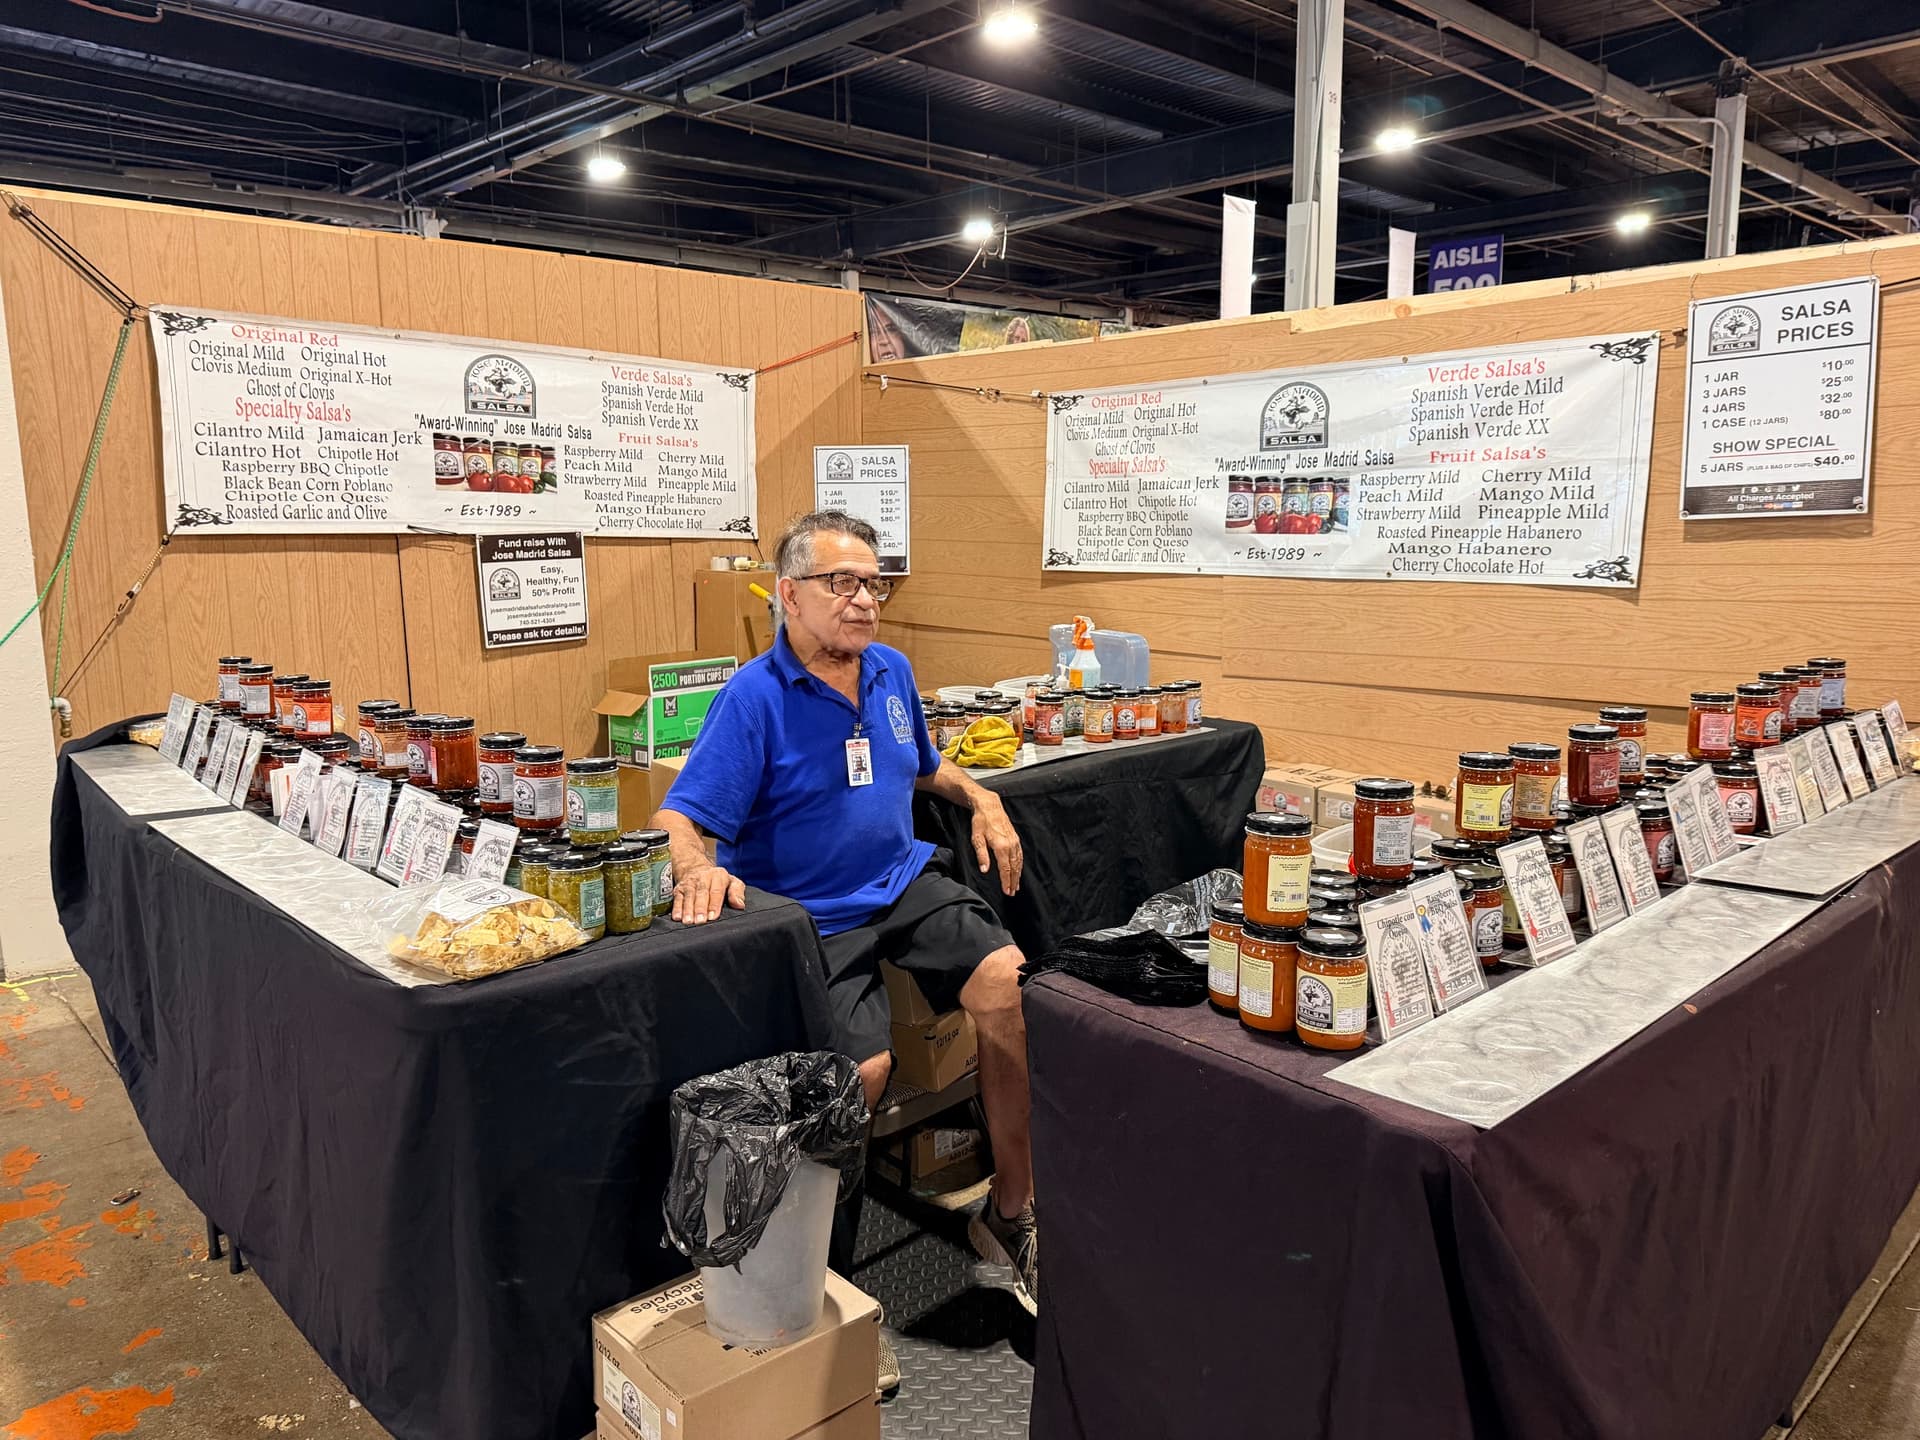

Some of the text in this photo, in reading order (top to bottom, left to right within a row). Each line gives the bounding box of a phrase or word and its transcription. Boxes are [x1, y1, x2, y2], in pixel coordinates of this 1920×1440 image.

[1434, 243, 1498, 269] AISLE
[1781, 299, 1851, 321] SALSA
[232, 324, 338, 347] Original Red
[1777, 321, 1854, 344] PRICES
[189, 340, 285, 361] Original Mild
[1717, 341, 1751, 350] SALSA
[300, 347, 386, 367] Original Hot
[191, 358, 292, 378] Clovis Medium
[300, 367, 392, 386] Original X-Hot
[1428, 358, 1546, 384] Verde Salsa's
[1705, 374, 1709, 383] 1
[1714, 372, 1739, 382] JAR
[246, 379, 335, 400] Ghost of Clovis
[1411, 376, 1563, 407] Spanish Verde Mild
[1703, 389, 1709, 398] 3
[1714, 386, 1746, 398] JARS
[236, 397, 351, 424] Specialty Salsa's
[477, 402, 524, 412] SALSA
[1411, 400, 1544, 425] Spanish Verde Hot
[1703, 405, 1709, 414] 4
[1713, 402, 1745, 413] JARS
[194, 422, 304, 440] Cilantro Mild
[415, 414, 592, 439] "Award-Winning" Jose Madrid Salsa
[1703, 420, 1707, 428] 1
[1712, 418, 1746, 428] CASE
[1749, 418, 1761, 427] (12
[1763, 417, 1788, 425] JARS)
[318, 427, 422, 447] Jamaican Jerk
[1409, 418, 1550, 445] Spanish Verde XX
[195, 442, 301, 459] Cilantro Hot
[1713, 435, 1835, 453] SHOW SPECIAL
[318, 446, 399, 462] Chipotle Hot
[862, 457, 895, 465] SALSA
[1430, 446, 1546, 464] Fruit Salsa's
[222, 460, 389, 477] Raspberry BBQ Chipotle
[860, 469, 898, 478] PRICES
[1481, 466, 1591, 484] Cherry Mild
[1701, 465, 1707, 473] 5
[1711, 463, 1743, 472] JARS
[224, 476, 392, 492] Black Bean Corn Poblano
[1360, 469, 1460, 490] Raspberry Mild
[225, 491, 298, 503] Chipotle
[303, 492, 335, 502] Con
[1359, 488, 1443, 503] Peach Mild
[1480, 486, 1595, 504] Mango Mild
[1776, 492, 1814, 501] Accepted
[226, 504, 388, 520] Roasted Garlic and Olive
[1356, 506, 1461, 523] Strawberry Mild
[1478, 504, 1609, 523] Pineapple Mild
[1377, 525, 1582, 542] Roasted Pineapple Habanero
[499, 537, 566, 548] Fund raise With
[1388, 542, 1552, 558] Mango Habanero
[492, 549, 571, 560] Jose Madrid Salsa
[540, 565, 563, 574] Easy,
[1392, 558, 1544, 575] Cherry Chocolate Hot
[526, 577, 561, 587] Healthy,
[553, 587, 575, 595] Profit
[492, 626, 584, 642] Please ask for details!
[652, 672, 722, 688] 2500 PORTION CUPS
[615, 742, 631, 755] 2500
[656, 746, 680, 759] 2500
[1426, 889, 1454, 904] Raspberry
[1377, 912, 1414, 930] Chipotle con
[1537, 926, 1563, 940] SALSA
[1445, 976, 1472, 993] SALSA
[1394, 1004, 1423, 1022] SALSA
[631, 1279, 703, 1314] Recycles
